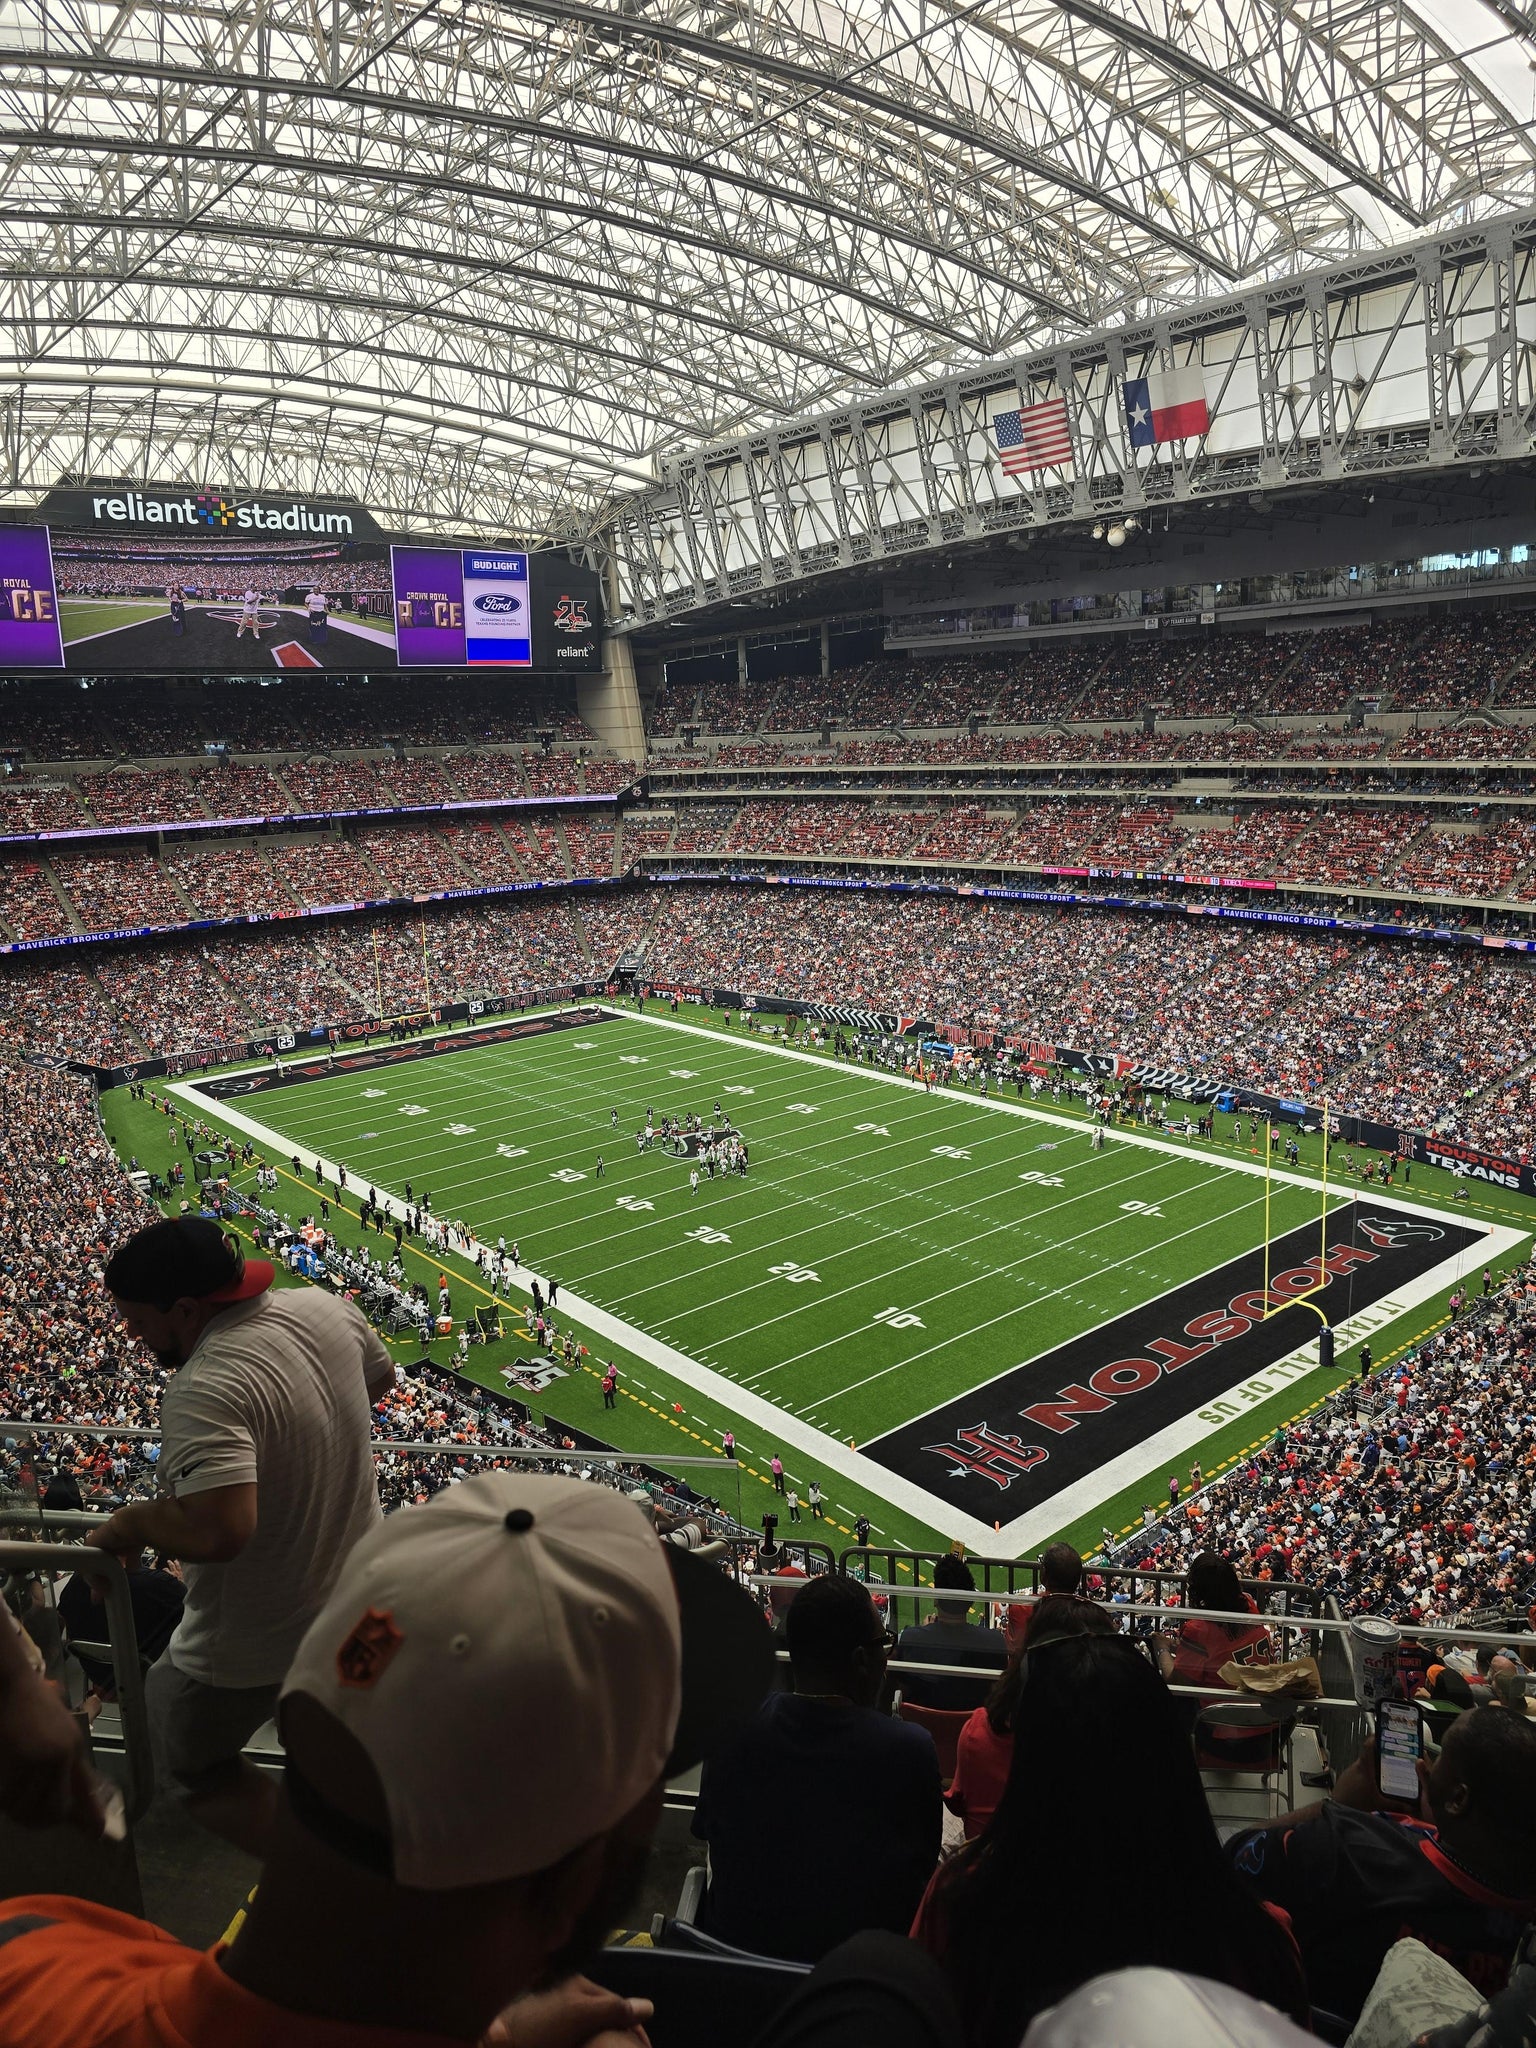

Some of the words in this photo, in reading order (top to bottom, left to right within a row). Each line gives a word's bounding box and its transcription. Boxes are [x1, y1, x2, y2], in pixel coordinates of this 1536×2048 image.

[93, 492, 199, 525] reliant
[237, 503, 353, 534] stadium
[474, 560, 493, 570] BUD
[493, 561, 518, 571] LIGHT
[3, 578, 31, 588] ROYAL
[406, 592, 428, 600] CROWN
[429, 593, 448, 601] ROYAL
[483, 596, 511, 612] Ford
[557, 600, 589, 628] 25
[557, 646, 589, 657] reliant
[449, 889, 482, 898] MAVERICK
[515, 883, 537, 891] SPORT
[988, 890, 1018, 898] MAVERICK
[1022, 892, 1048, 900] BRONCO
[1050, 894, 1070, 902] SPORT
[1224, 909, 1262, 920] MAVERICK
[1267, 913, 1300, 923] BRONCO
[1303, 917, 1330, 926] SPORT
[18, 939, 66, 950] MAVERICK
[73, 933, 111, 943] BRONCO
[114, 929, 143, 938] SPORT
[652, 983, 702, 995] HOUSTON
[471, 1002, 482, 1012] 25
[281, 1037, 293, 1047] 25
[289, 1022, 553, 1077] TEXANS
[1004, 1036, 1057, 1062] TEXANS
[182, 1051, 216, 1070] TOWN
[217, 1044, 248, 1064] MADE
[785, 1103, 820, 1114] 50
[853, 1122, 891, 1136] 40
[930, 1145, 971, 1159] 30
[1425, 1140, 1521, 1176] HOUSTON
[549, 1168, 588, 1183] 50
[1425, 1151, 1520, 1189] TEXANS
[1018, 1171, 1064, 1187] 20
[1119, 1200, 1161, 1216] 10
[684, 1225, 729, 1244] 30
[767, 1262, 818, 1283] 20
[1376, 1300, 1406, 1315] IT
[873, 1306, 921, 1329] 10
[1018, 1243, 1381, 1434] HOUSTON
[1266, 1352, 1319, 1379] ALL
[1238, 1380, 1274, 1402] OF
[1197, 1401, 1242, 1424] US
[1396, 1669, 1426, 1699] 12
